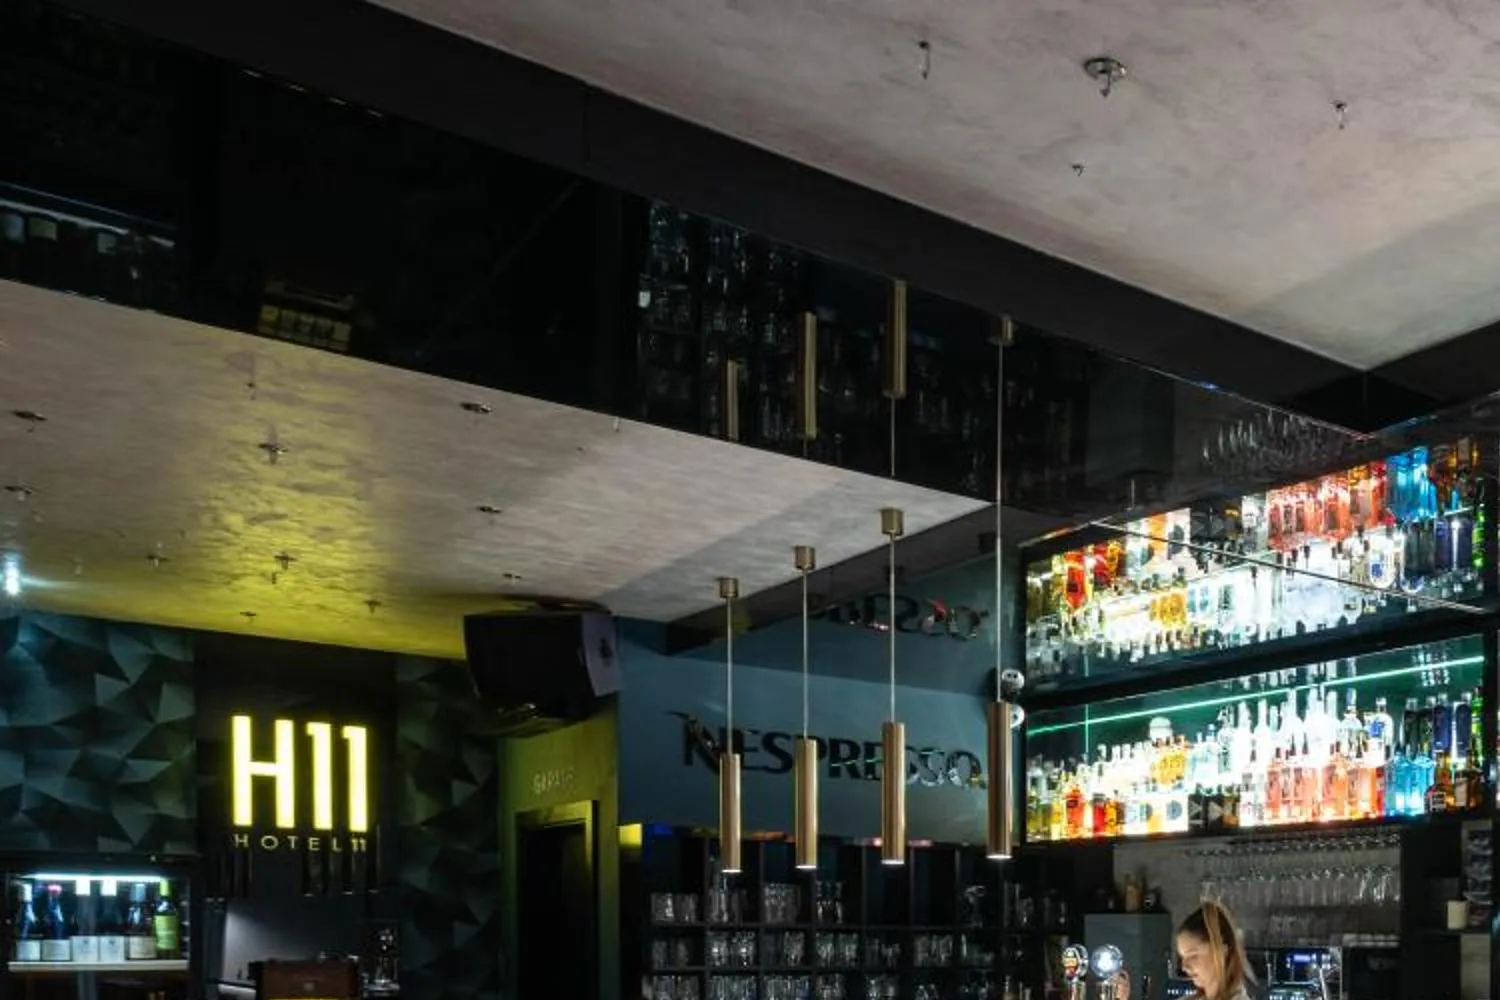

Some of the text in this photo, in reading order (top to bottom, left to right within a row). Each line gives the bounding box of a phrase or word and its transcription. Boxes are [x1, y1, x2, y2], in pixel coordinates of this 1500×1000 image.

[232, 715, 367, 833] H11
[234, 833, 367, 852] HOTEL 11
